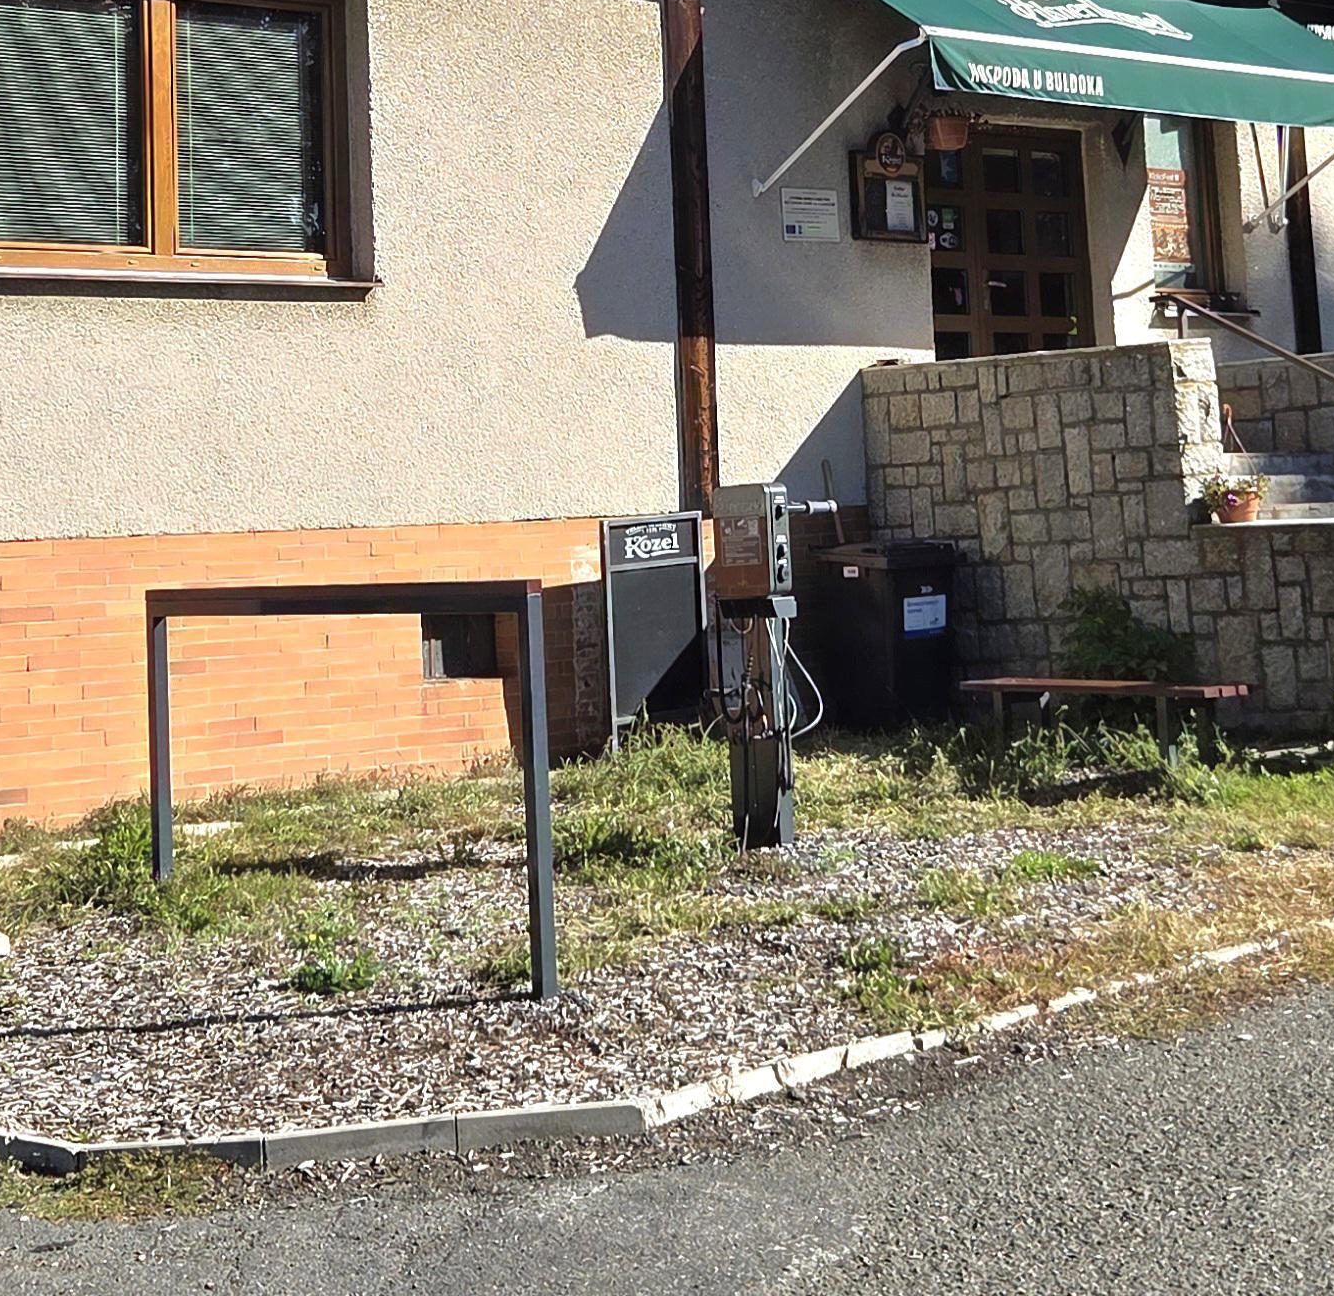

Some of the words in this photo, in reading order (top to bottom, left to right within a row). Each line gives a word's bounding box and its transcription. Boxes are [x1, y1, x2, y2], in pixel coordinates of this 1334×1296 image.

[968, 62, 1031, 90] HOSPODA
[1033, 69, 1043, 91] U
[1045, 71, 1105, 97] BULDOKA
[624, 532, 680, 559] Kozel
